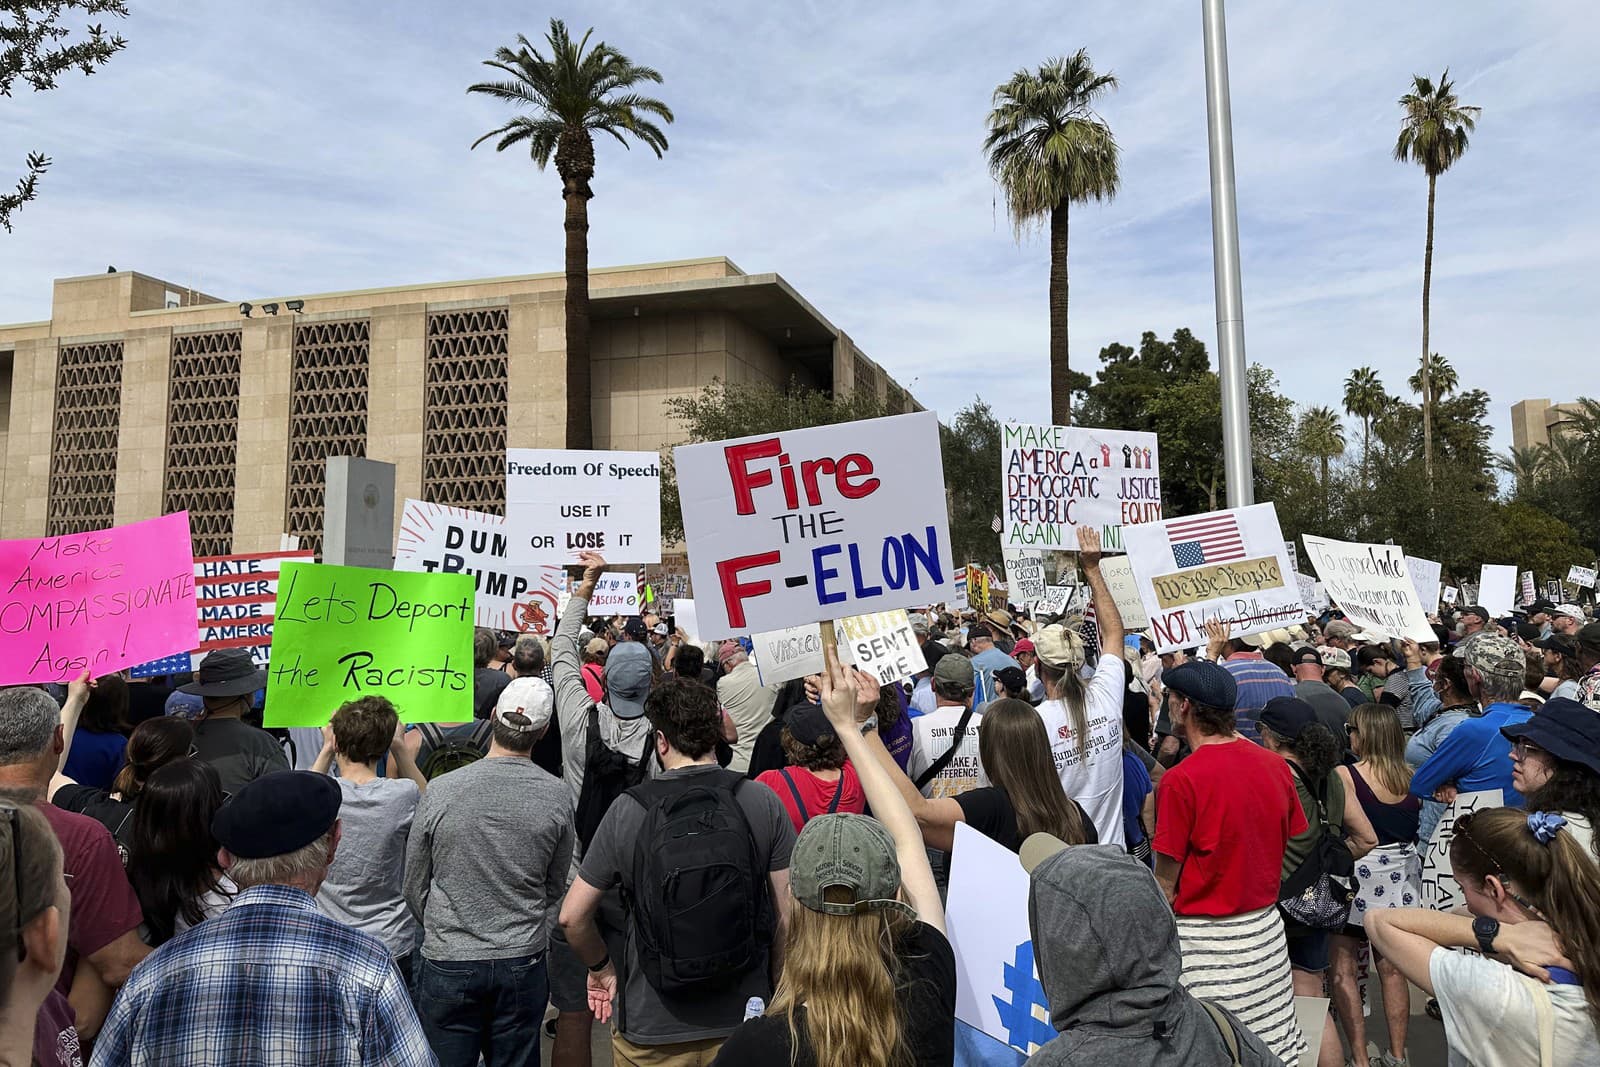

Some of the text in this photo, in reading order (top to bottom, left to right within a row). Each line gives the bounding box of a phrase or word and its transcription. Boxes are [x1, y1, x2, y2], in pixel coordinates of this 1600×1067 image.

[1005, 425, 1065, 449] MAKE
[508, 461, 660, 479] Freedom Of Speech
[1008, 449, 1098, 475] AMERICA a
[723, 437, 881, 516] Fire
[1008, 475, 1100, 499] DEMOCRATIC
[1117, 477, 1160, 500] JUSTICE
[560, 505, 610, 518] USE IT
[1010, 499, 1077, 525] REPUBLIC
[1122, 502, 1161, 525] EQUITY
[771, 510, 845, 544] THE
[1010, 523, 1061, 545] AGAIN
[30, 536, 113, 561] Make
[445, 526, 507, 558] DUM
[531, 532, 632, 549] OR LOSE IT
[203, 559, 262, 578] HATE
[1307, 541, 1335, 571] To
[1368, 547, 1404, 579] hate
[8, 565, 125, 594] America
[610, 580, 620, 589] NO
[716, 525, 945, 629] F-ELON
[1156, 578, 1190, 601] We
[1189, 571, 1219, 598] the
[1216, 561, 1279, 596] People
[202, 580, 274, 600] NEVER
[278, 570, 471, 632] Let's Deport
[590, 595, 624, 606] FASCISM
[1392, 590, 1409, 606] an
[0, 573, 193, 634] OMPASSIONATE
[202, 604, 262, 622] MADE
[205, 623, 275, 642] AMERIC
[1151, 610, 1190, 648] NOT
[1235, 599, 1305, 632] Billionaires
[856, 627, 911, 662] SENT
[272, 651, 467, 691] the Racists
[877, 656, 913, 684] ME
[931, 727, 976, 738] SUN DILS
[931, 737, 978, 757] UNTE
[936, 768, 978, 779] IFFERENCE
[972, 757, 979, 767] A
